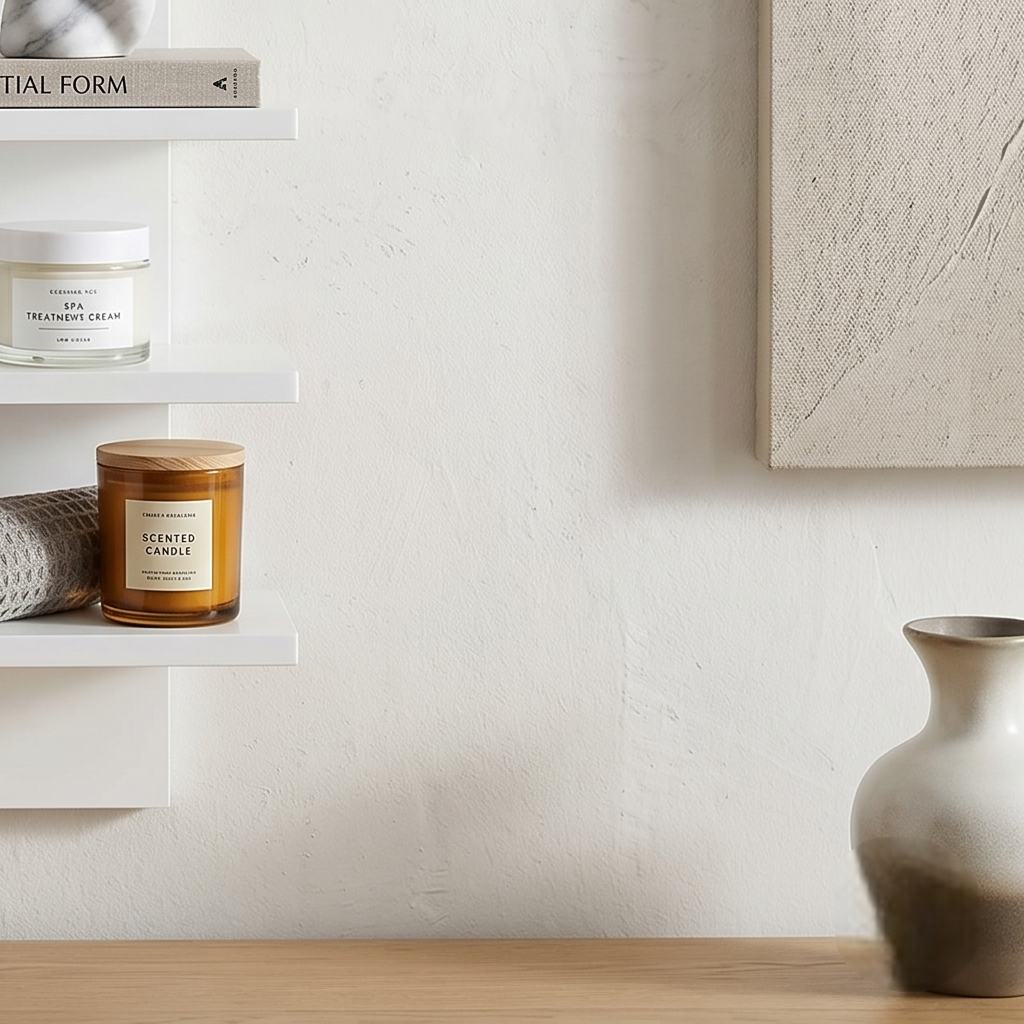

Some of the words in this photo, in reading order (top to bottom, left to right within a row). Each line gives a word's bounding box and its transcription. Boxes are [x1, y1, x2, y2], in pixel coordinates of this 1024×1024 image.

[60, 75, 128, 95] FORM
[64, 302, 84, 311] SPA
[141, 532, 195, 543] SCENTED
[145, 546, 191, 556] CANDLE
